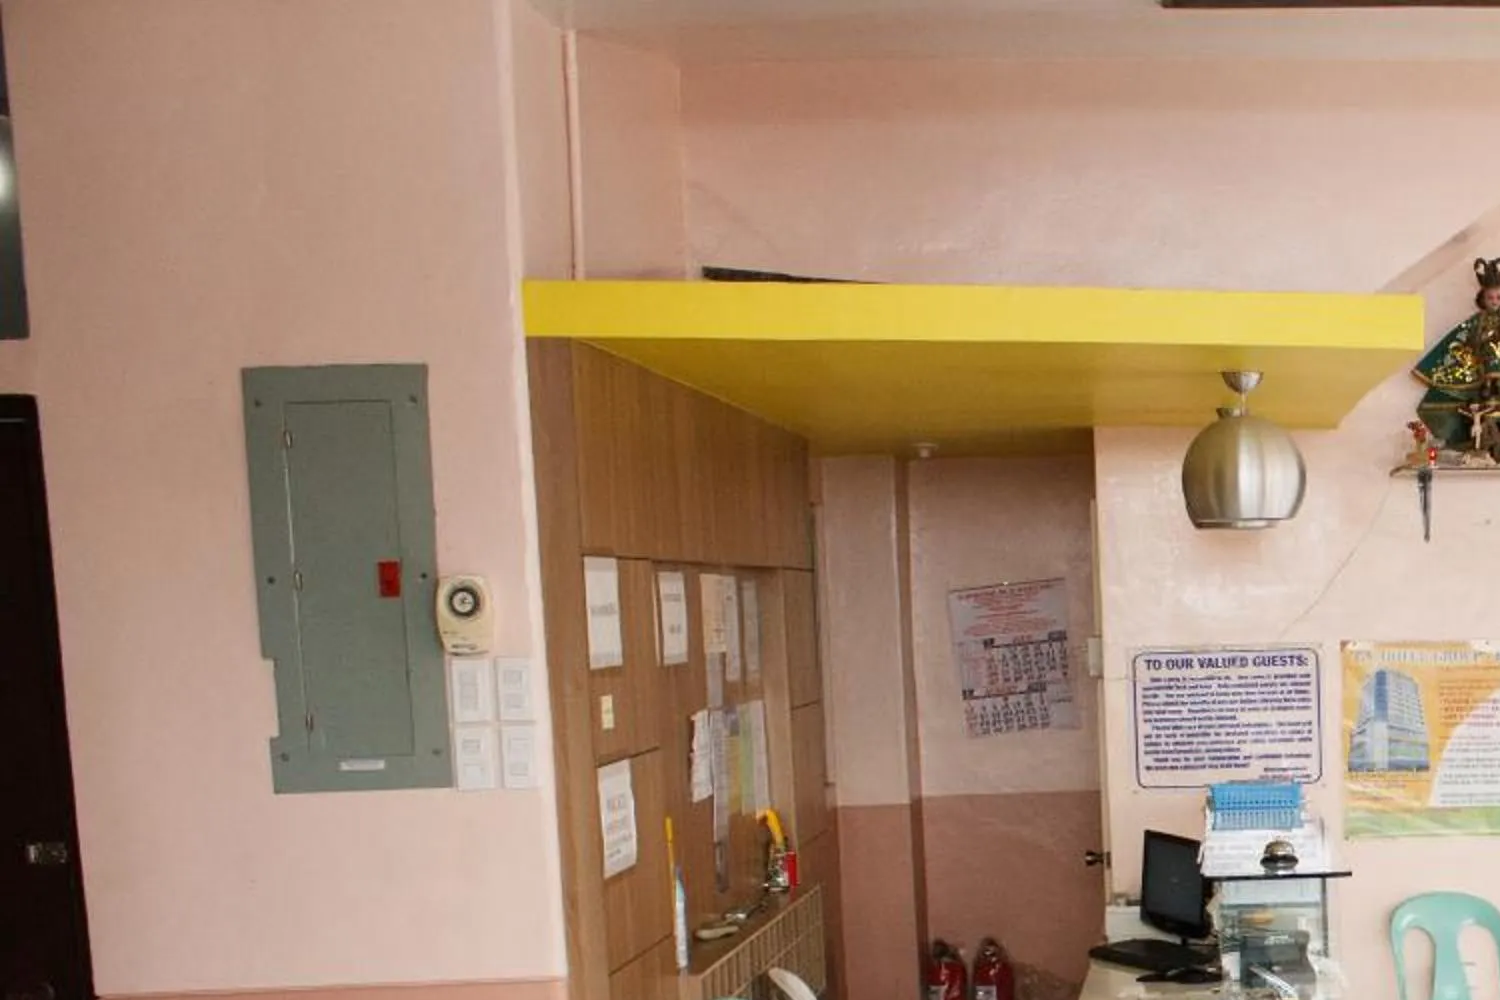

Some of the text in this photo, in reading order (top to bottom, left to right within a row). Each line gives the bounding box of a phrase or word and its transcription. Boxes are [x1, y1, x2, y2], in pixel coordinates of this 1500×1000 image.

[1144, 654, 1309, 671] TO OUR VALUED GUESTS:
